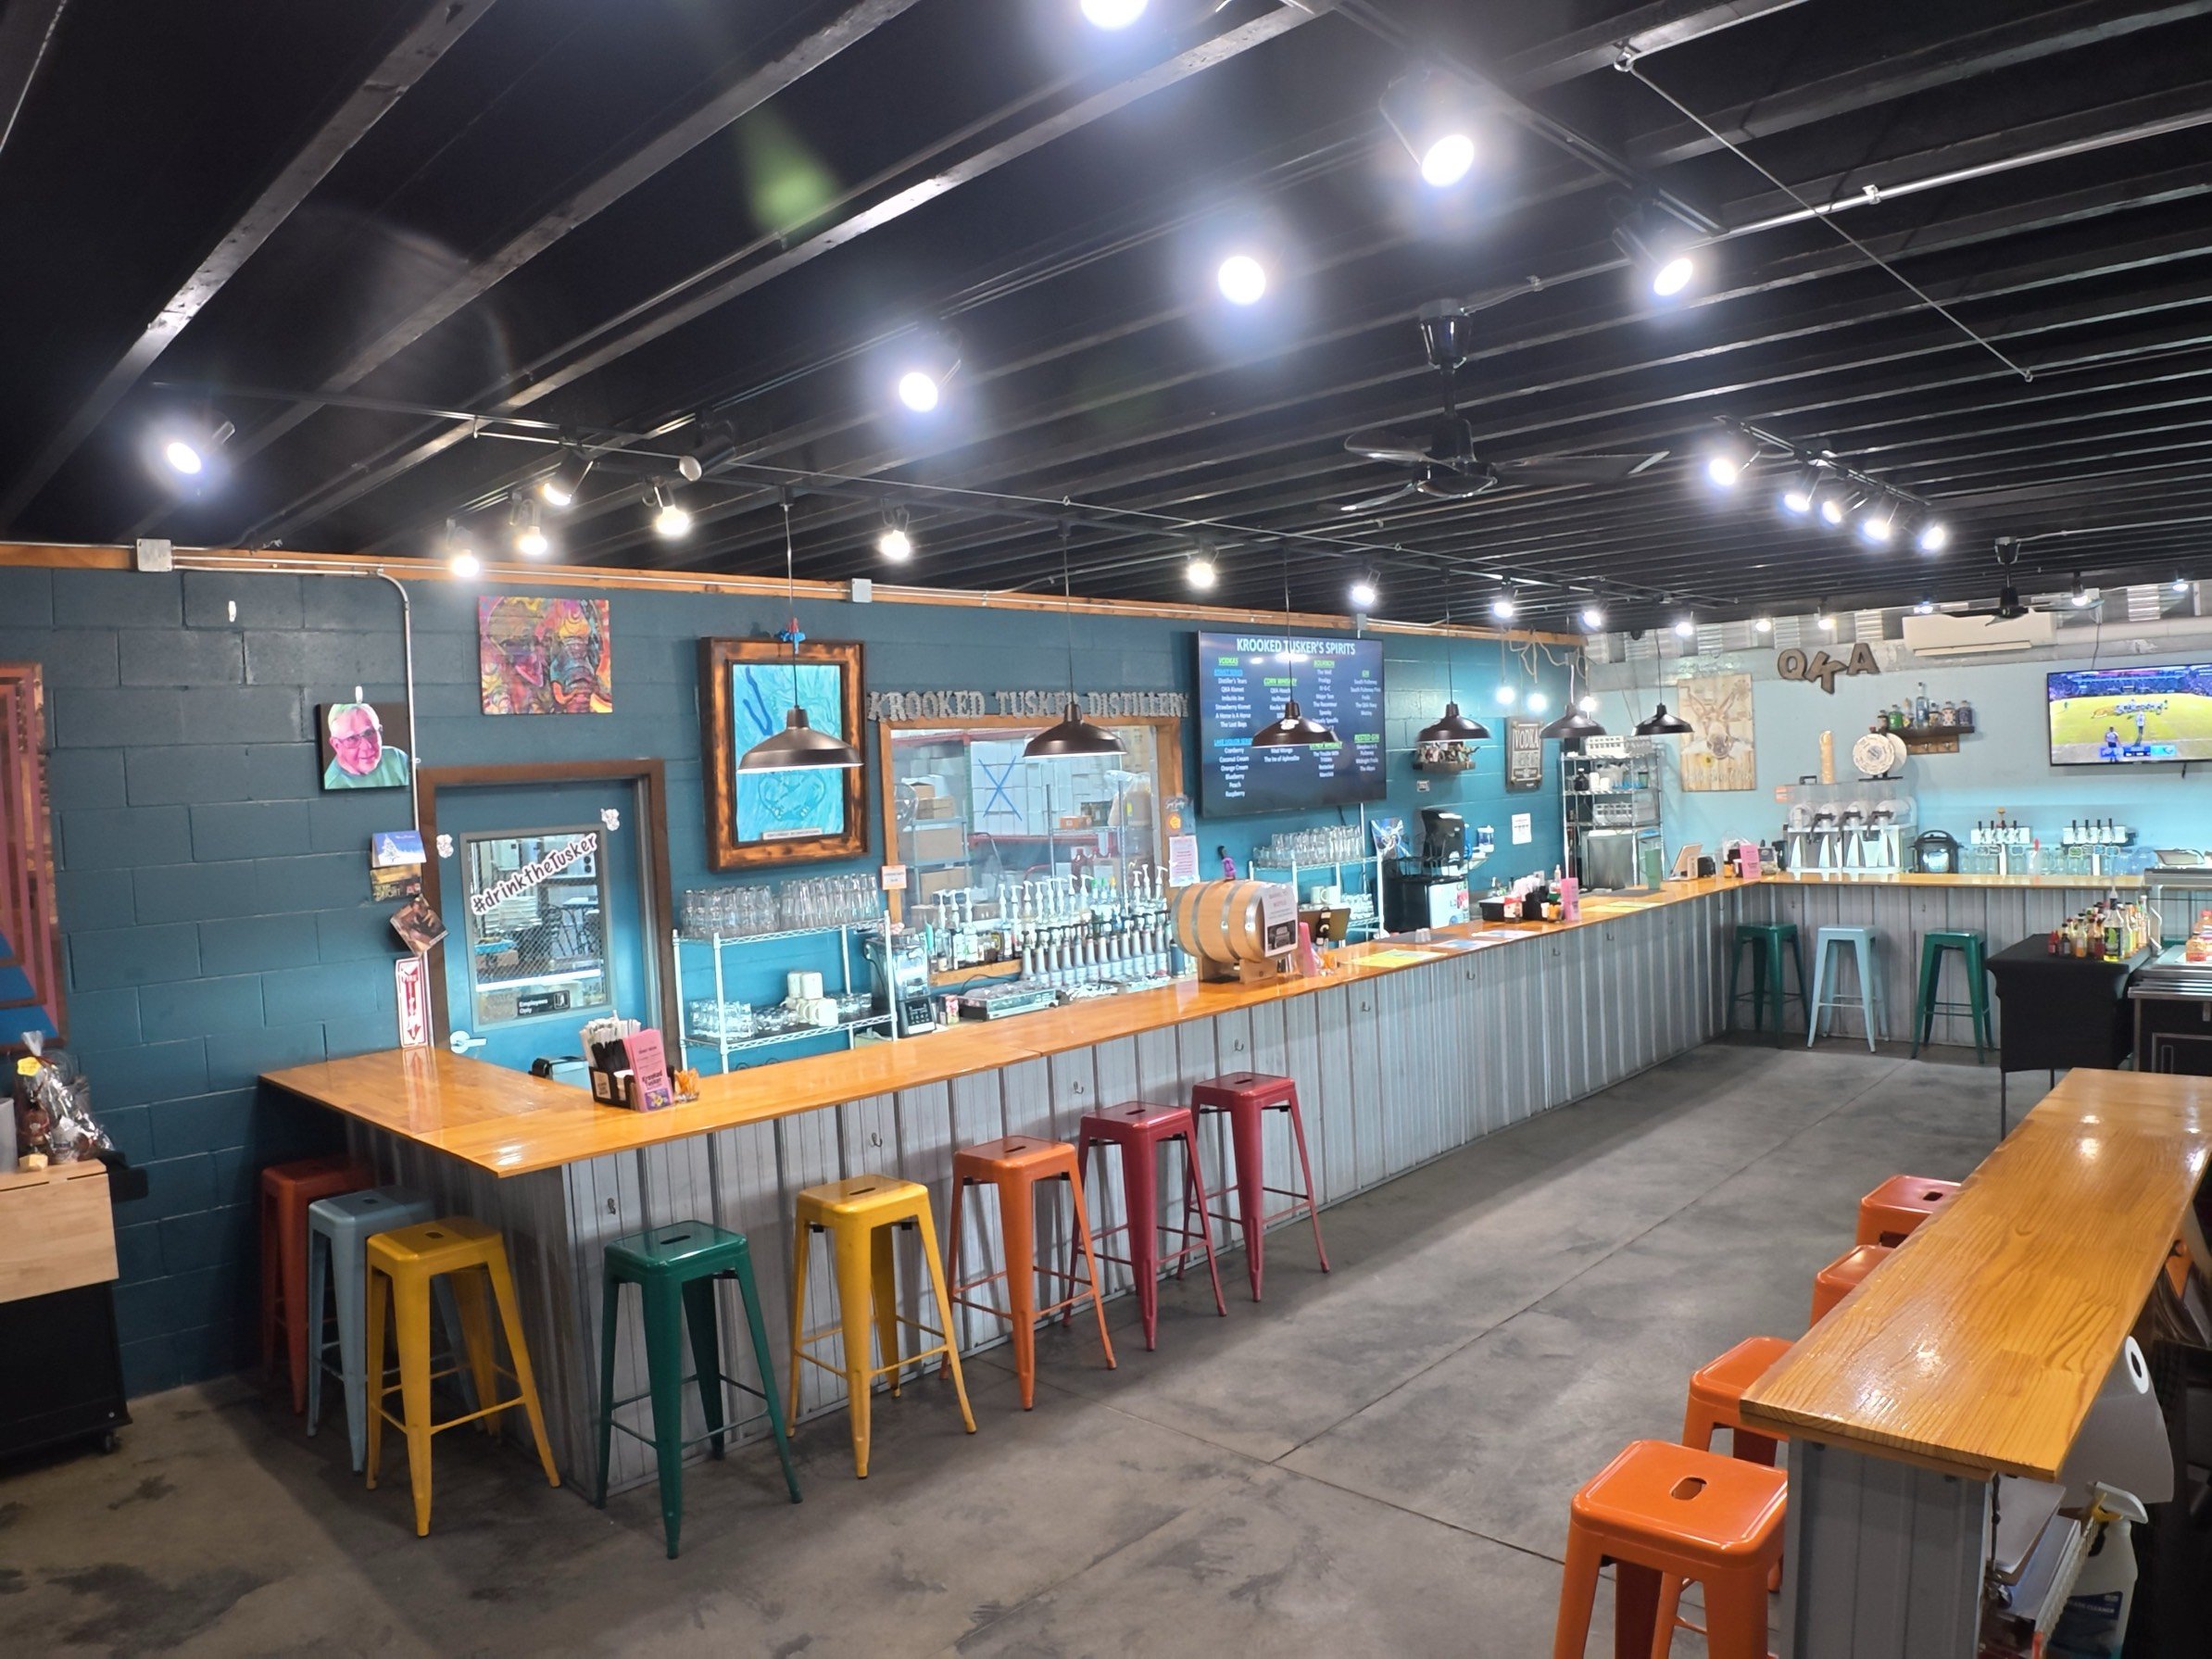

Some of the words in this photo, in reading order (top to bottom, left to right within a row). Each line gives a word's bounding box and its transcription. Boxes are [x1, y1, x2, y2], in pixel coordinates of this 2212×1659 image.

[1237, 638, 1281, 652] KROOKED
[1283, 640, 1324, 654] TUSKER'S
[1326, 642, 1356, 655] SPIRITS
[868, 691, 985, 722] KROOKED
[1087, 691, 1188, 718] DISTILLERY
[1514, 728, 1539, 748] VODKA
[471, 835, 597, 912] #drinktheTusker
[519, 999, 547, 1008] Employees
[2086, 1603, 2115, 1613] CLEANER
